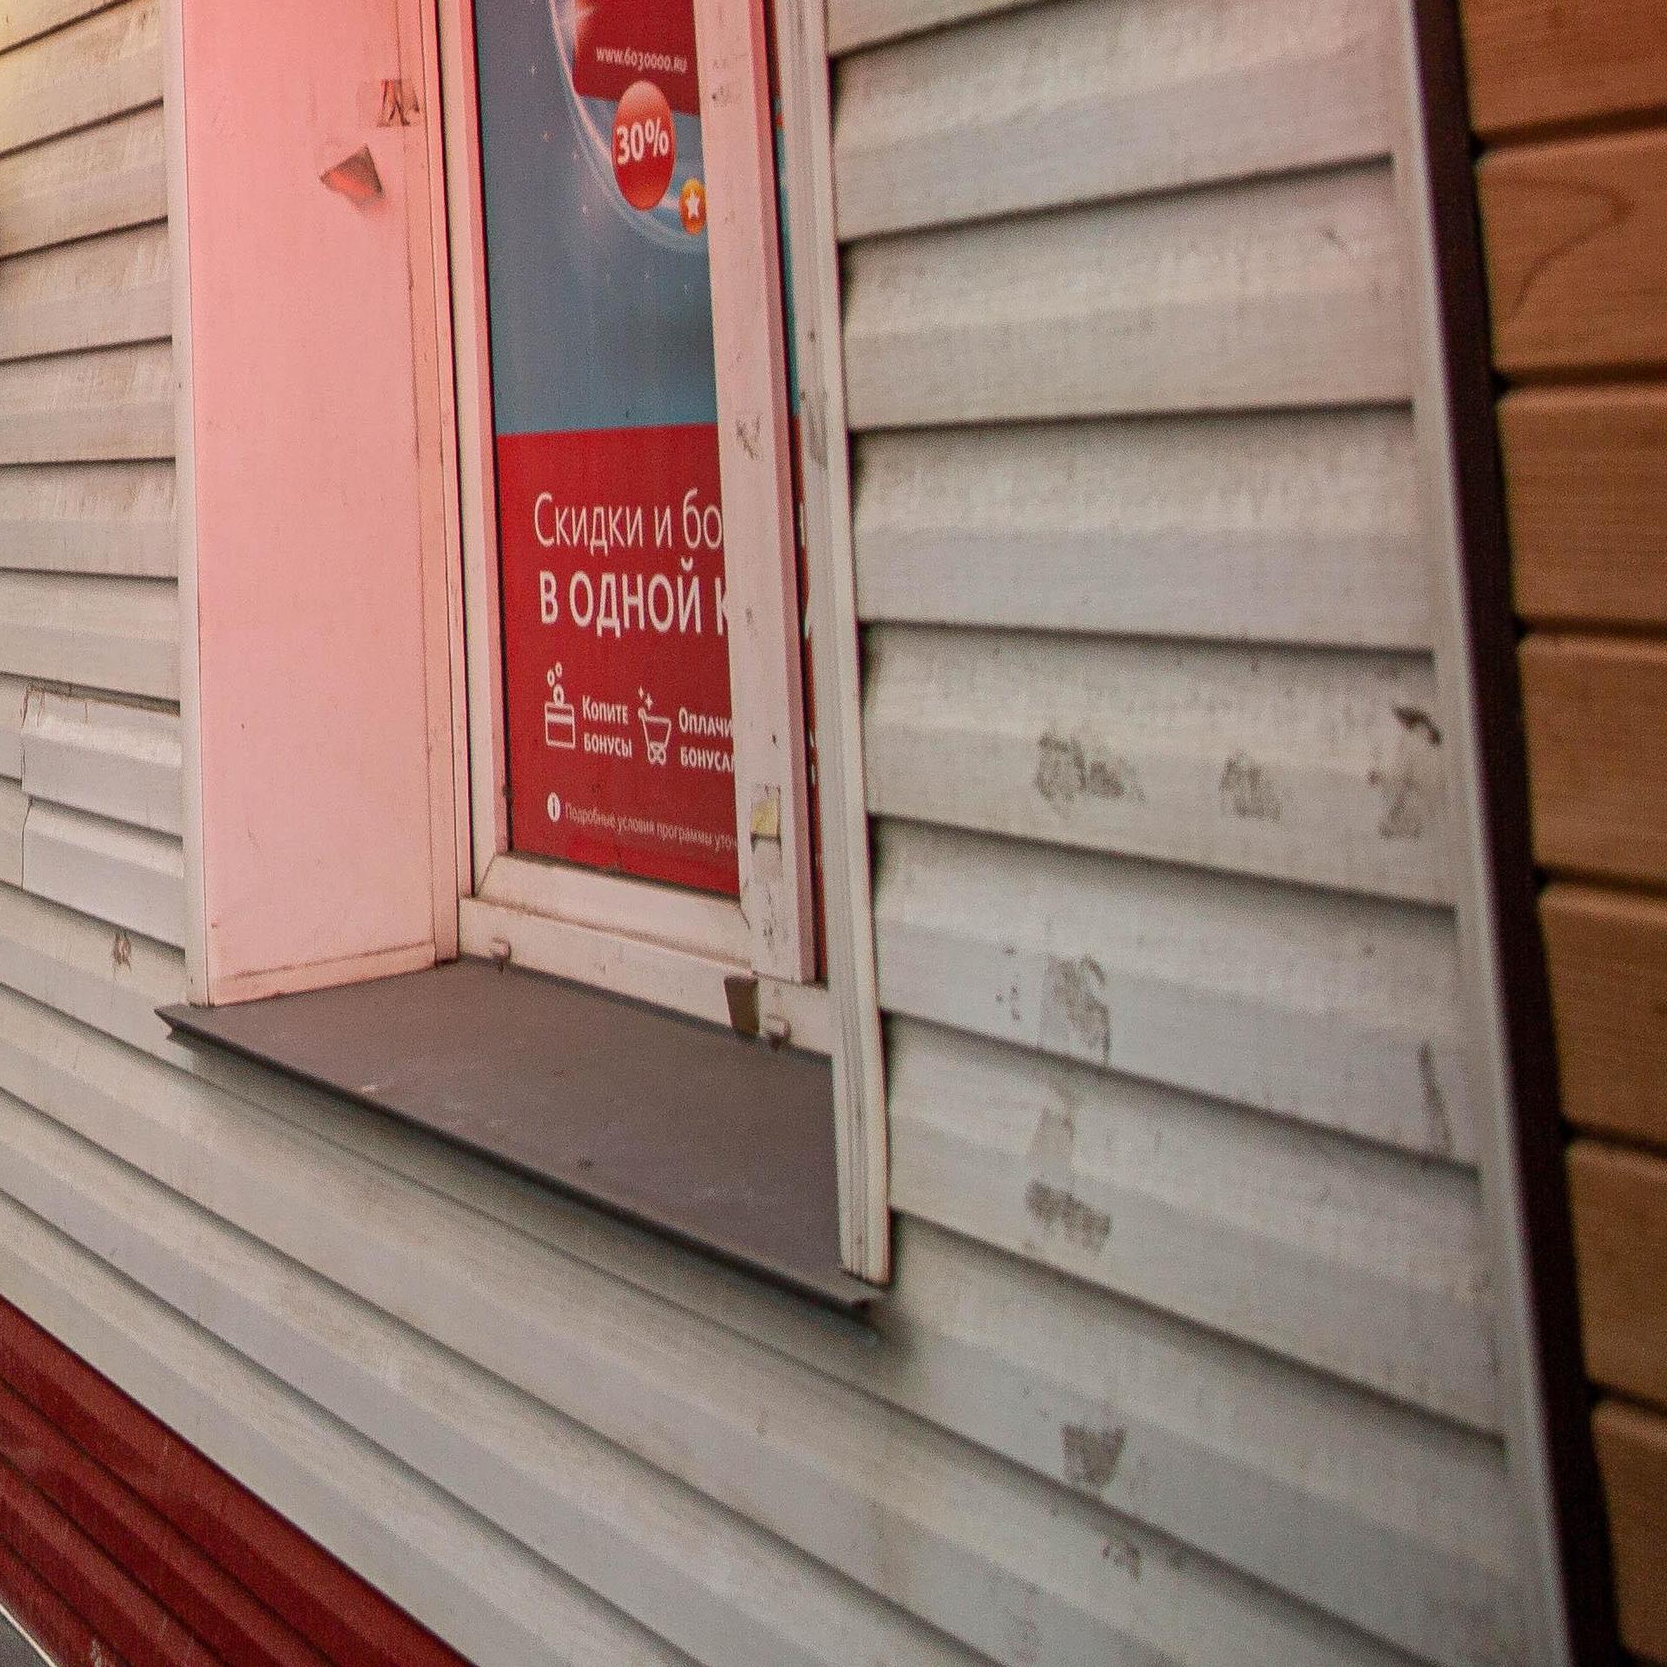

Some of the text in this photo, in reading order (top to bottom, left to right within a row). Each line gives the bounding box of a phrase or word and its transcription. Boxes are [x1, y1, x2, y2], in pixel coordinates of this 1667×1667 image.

[617, 117, 670, 166] 30%
[534, 491, 643, 557] Скидки
[654, 505, 673, 549] и
[539, 570, 559, 625] В
[569, 555, 701, 638] ОДНОЙ
